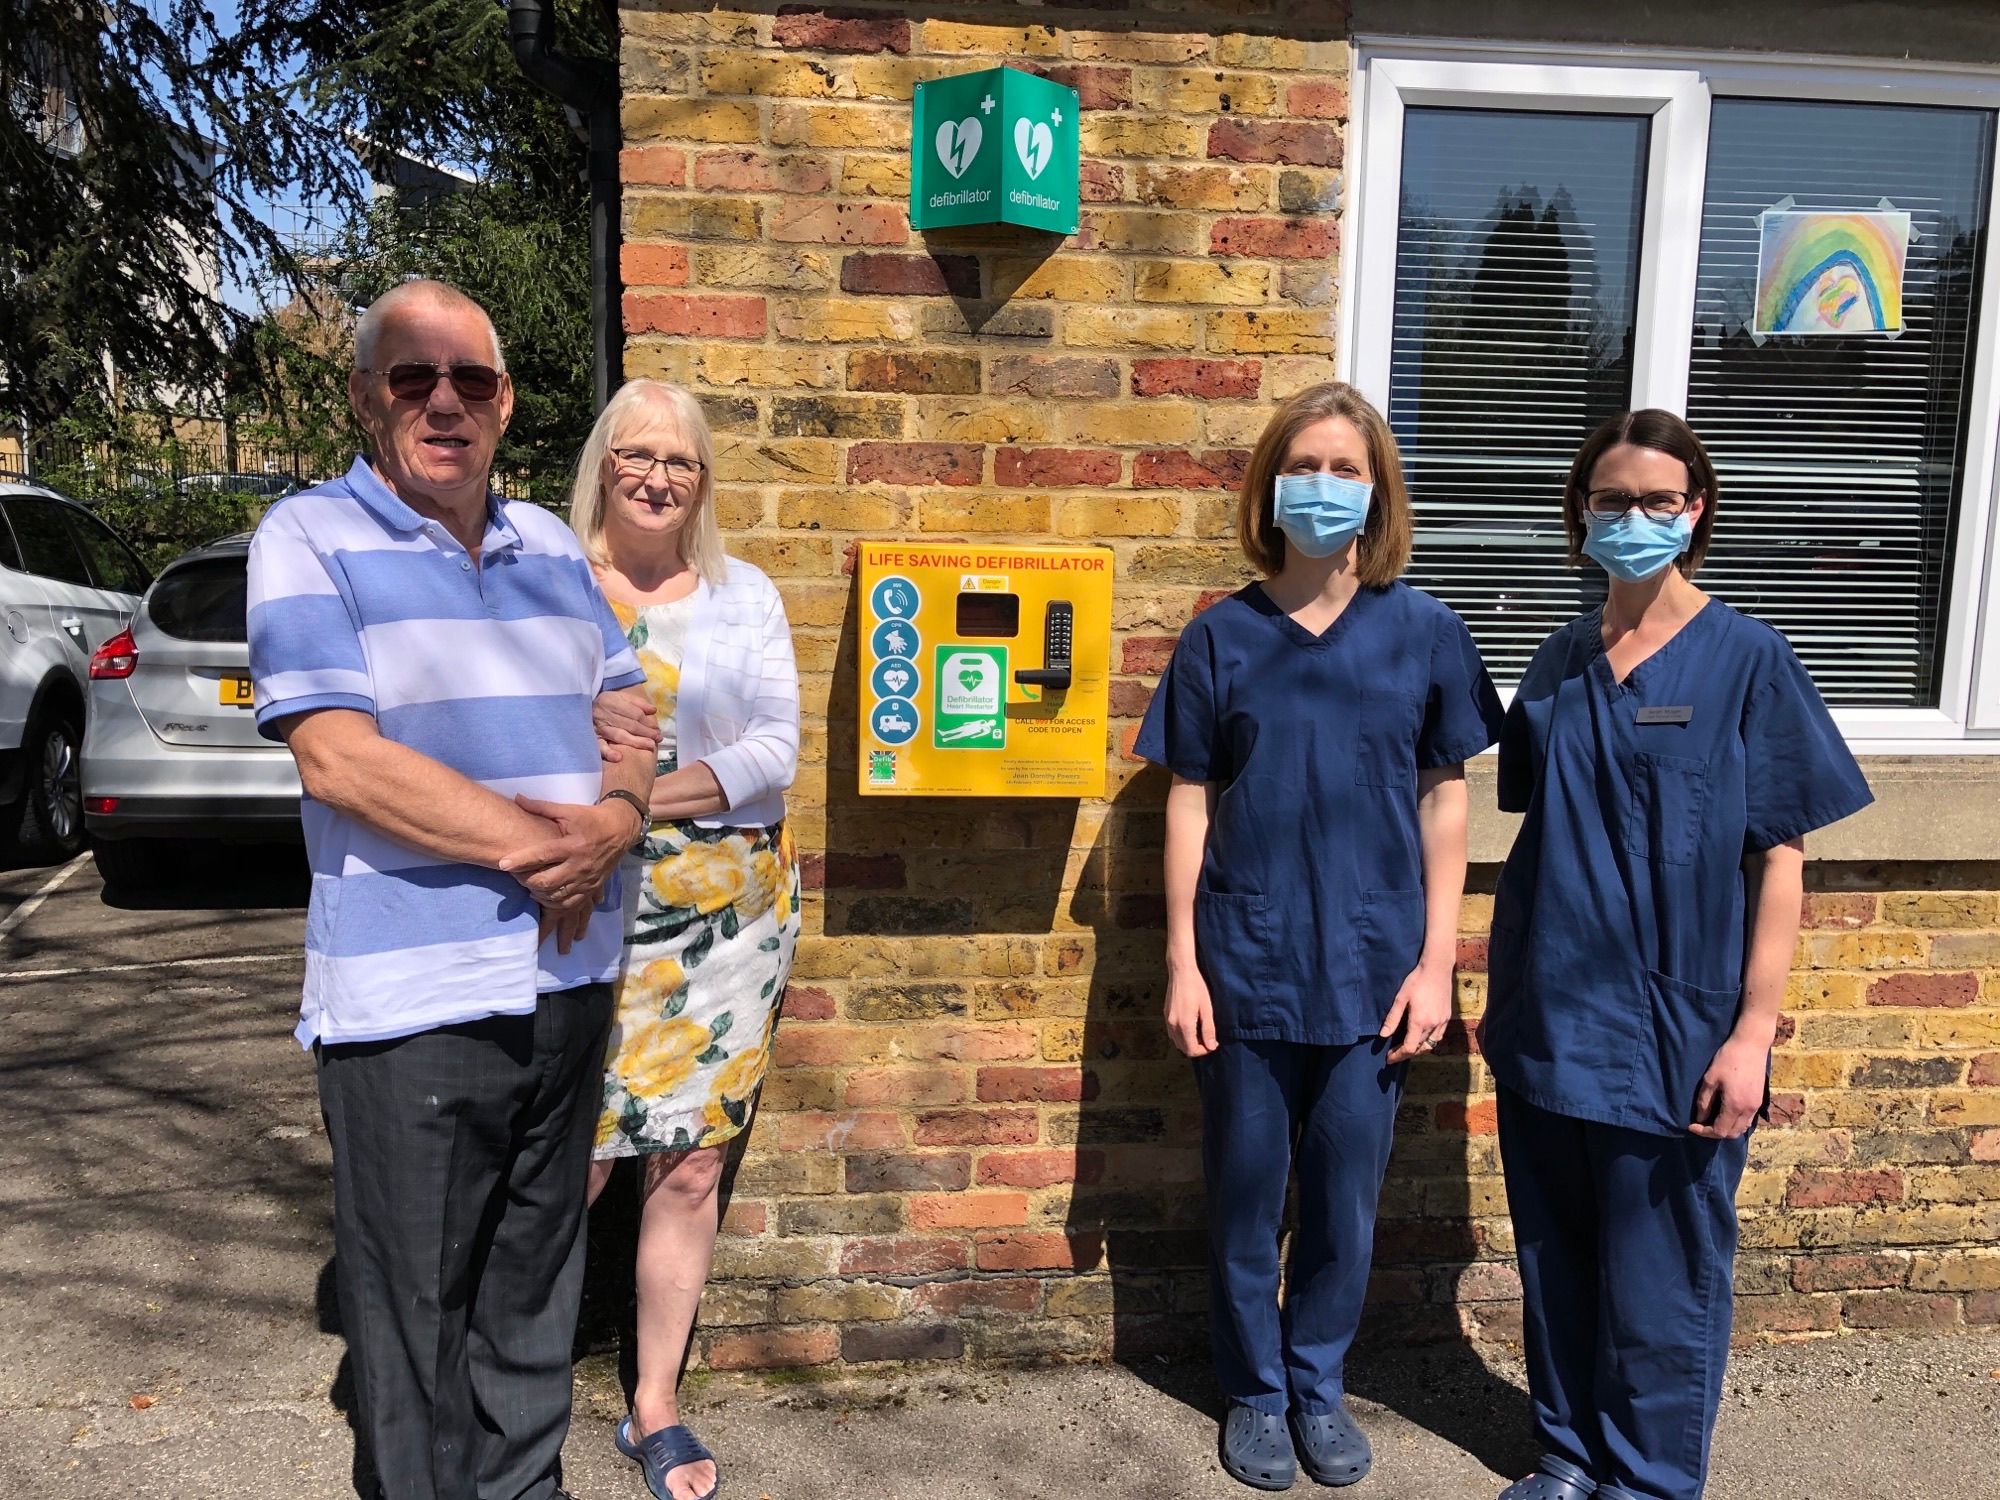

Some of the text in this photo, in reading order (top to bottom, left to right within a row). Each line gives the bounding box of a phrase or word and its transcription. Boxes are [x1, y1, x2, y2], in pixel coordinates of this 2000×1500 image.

[929, 188, 992, 208] defibrillator
[1009, 188, 1061, 211] defibrillator
[869, 553, 1105, 572] LIFE SAVING DEFIBRILLATOR
[946, 695, 994, 703] Defibrillator
